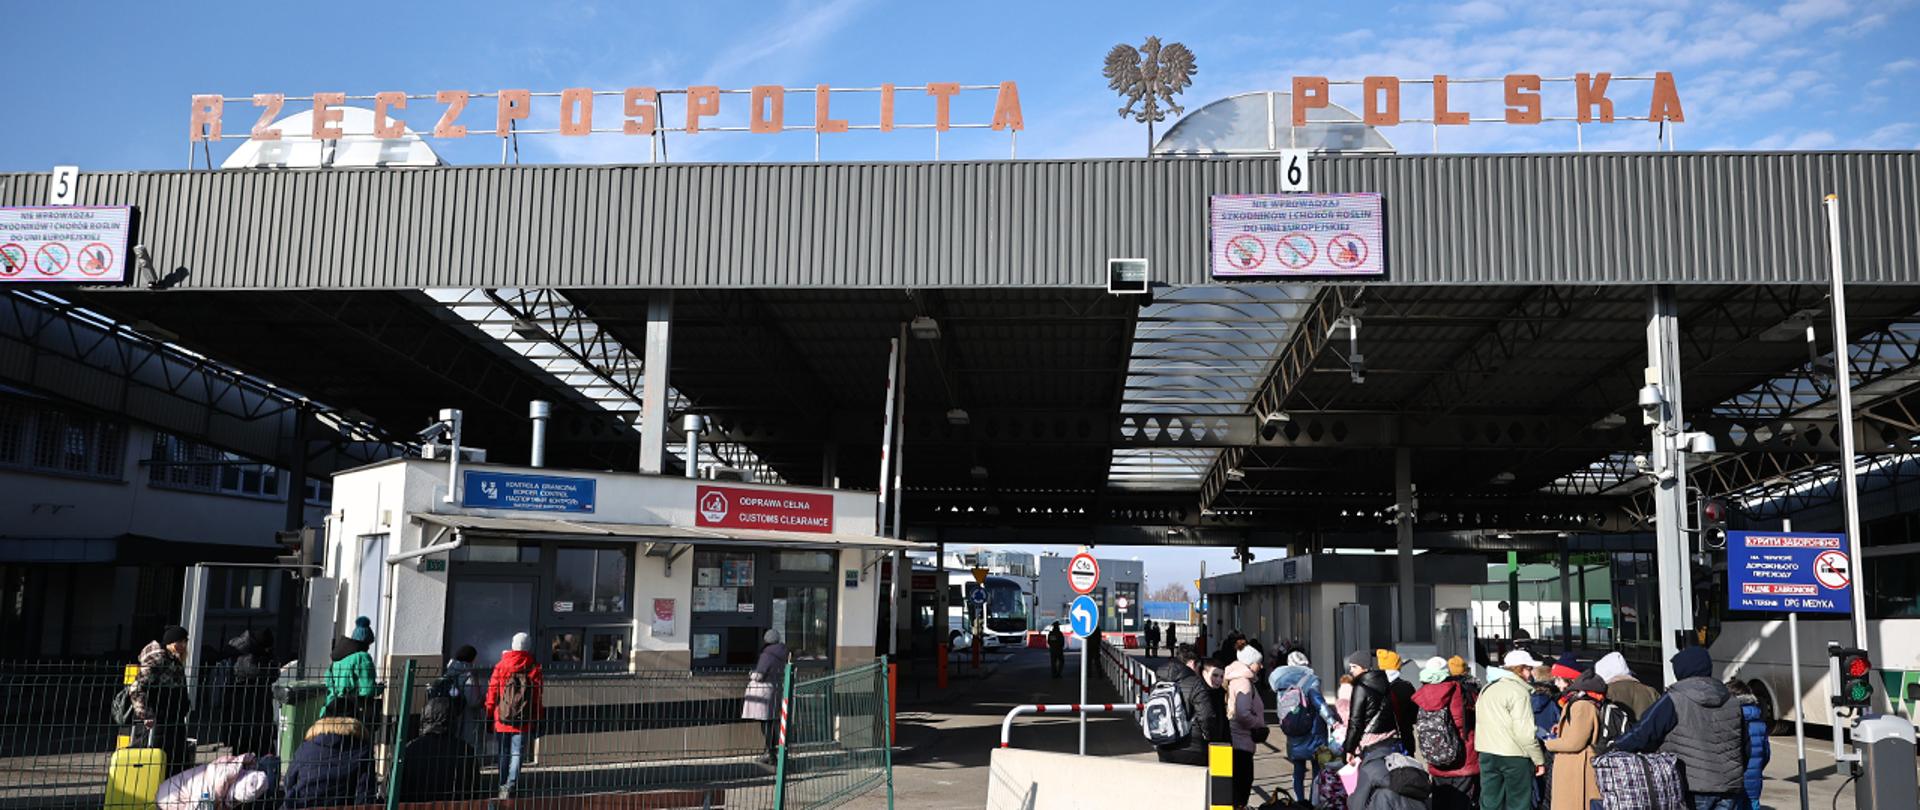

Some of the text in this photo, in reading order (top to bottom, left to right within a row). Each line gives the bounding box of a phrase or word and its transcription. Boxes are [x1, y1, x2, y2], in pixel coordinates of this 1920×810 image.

[190, 72, 1685, 142] RZECZPOSPOLITA POLSKA
[1287, 155, 1302, 185] 6
[57, 171, 70, 198] 5
[1252, 200, 1340, 208] NIE WPROWADZAJ
[1243, 224, 1257, 232] DO
[1282, 223, 1350, 232] EUROPEJSKIEJ
[43, 233, 100, 241] EUROPEJSKIEJ
[542, 483, 576, 491] GRANICZNA
[540, 490, 568, 498] CONTROL
[739, 497, 810, 510] ODPRAWA CELNA
[739, 513, 829, 527] CUSTOMS CLEARANCE
[1746, 536, 1781, 547] КУРИТИ
[1784, 598, 1800, 608] DPG
[1802, 599, 1834, 609] MEDYKA
